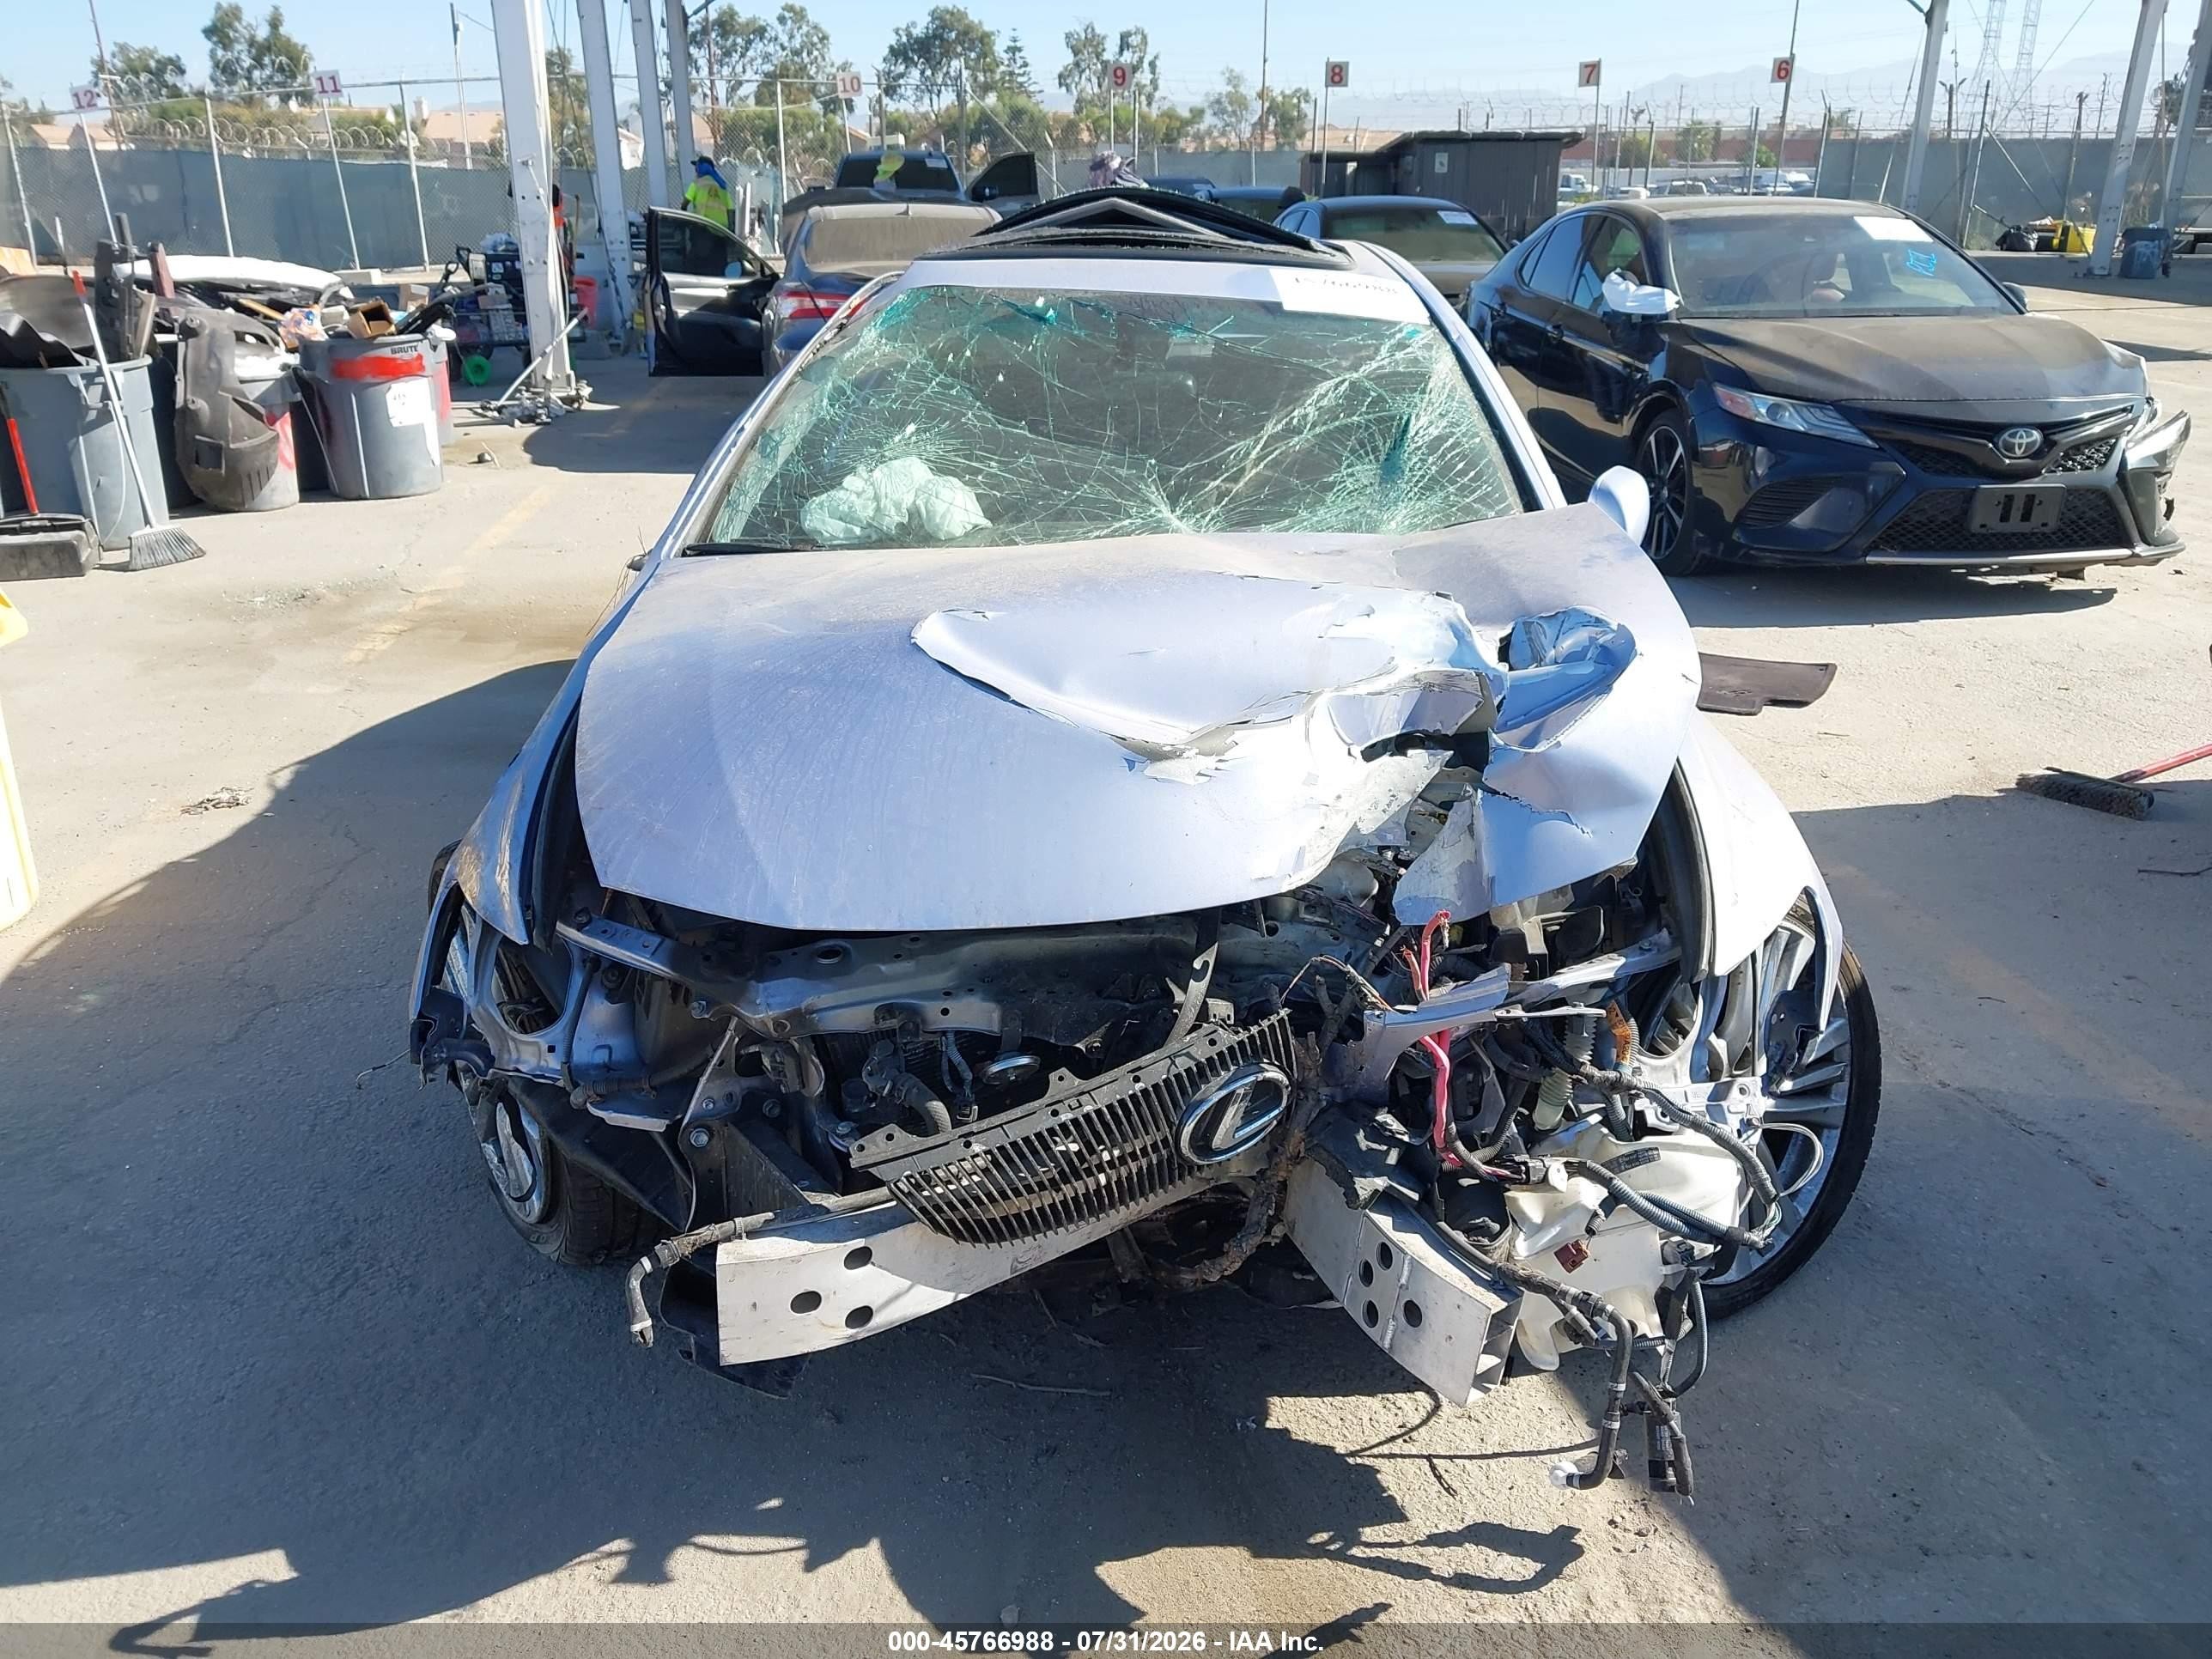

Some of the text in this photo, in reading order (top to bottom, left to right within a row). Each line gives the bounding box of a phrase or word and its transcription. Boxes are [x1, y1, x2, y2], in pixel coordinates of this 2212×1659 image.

[1114, 66, 1126, 87] 9
[1332, 64, 1343, 84] 8
[1584, 64, 1596, 83] 7
[1778, 60, 1790, 80] 6
[316, 76, 342, 94] 11
[839, 76, 861, 93] 10
[72, 89, 97, 109] 12
